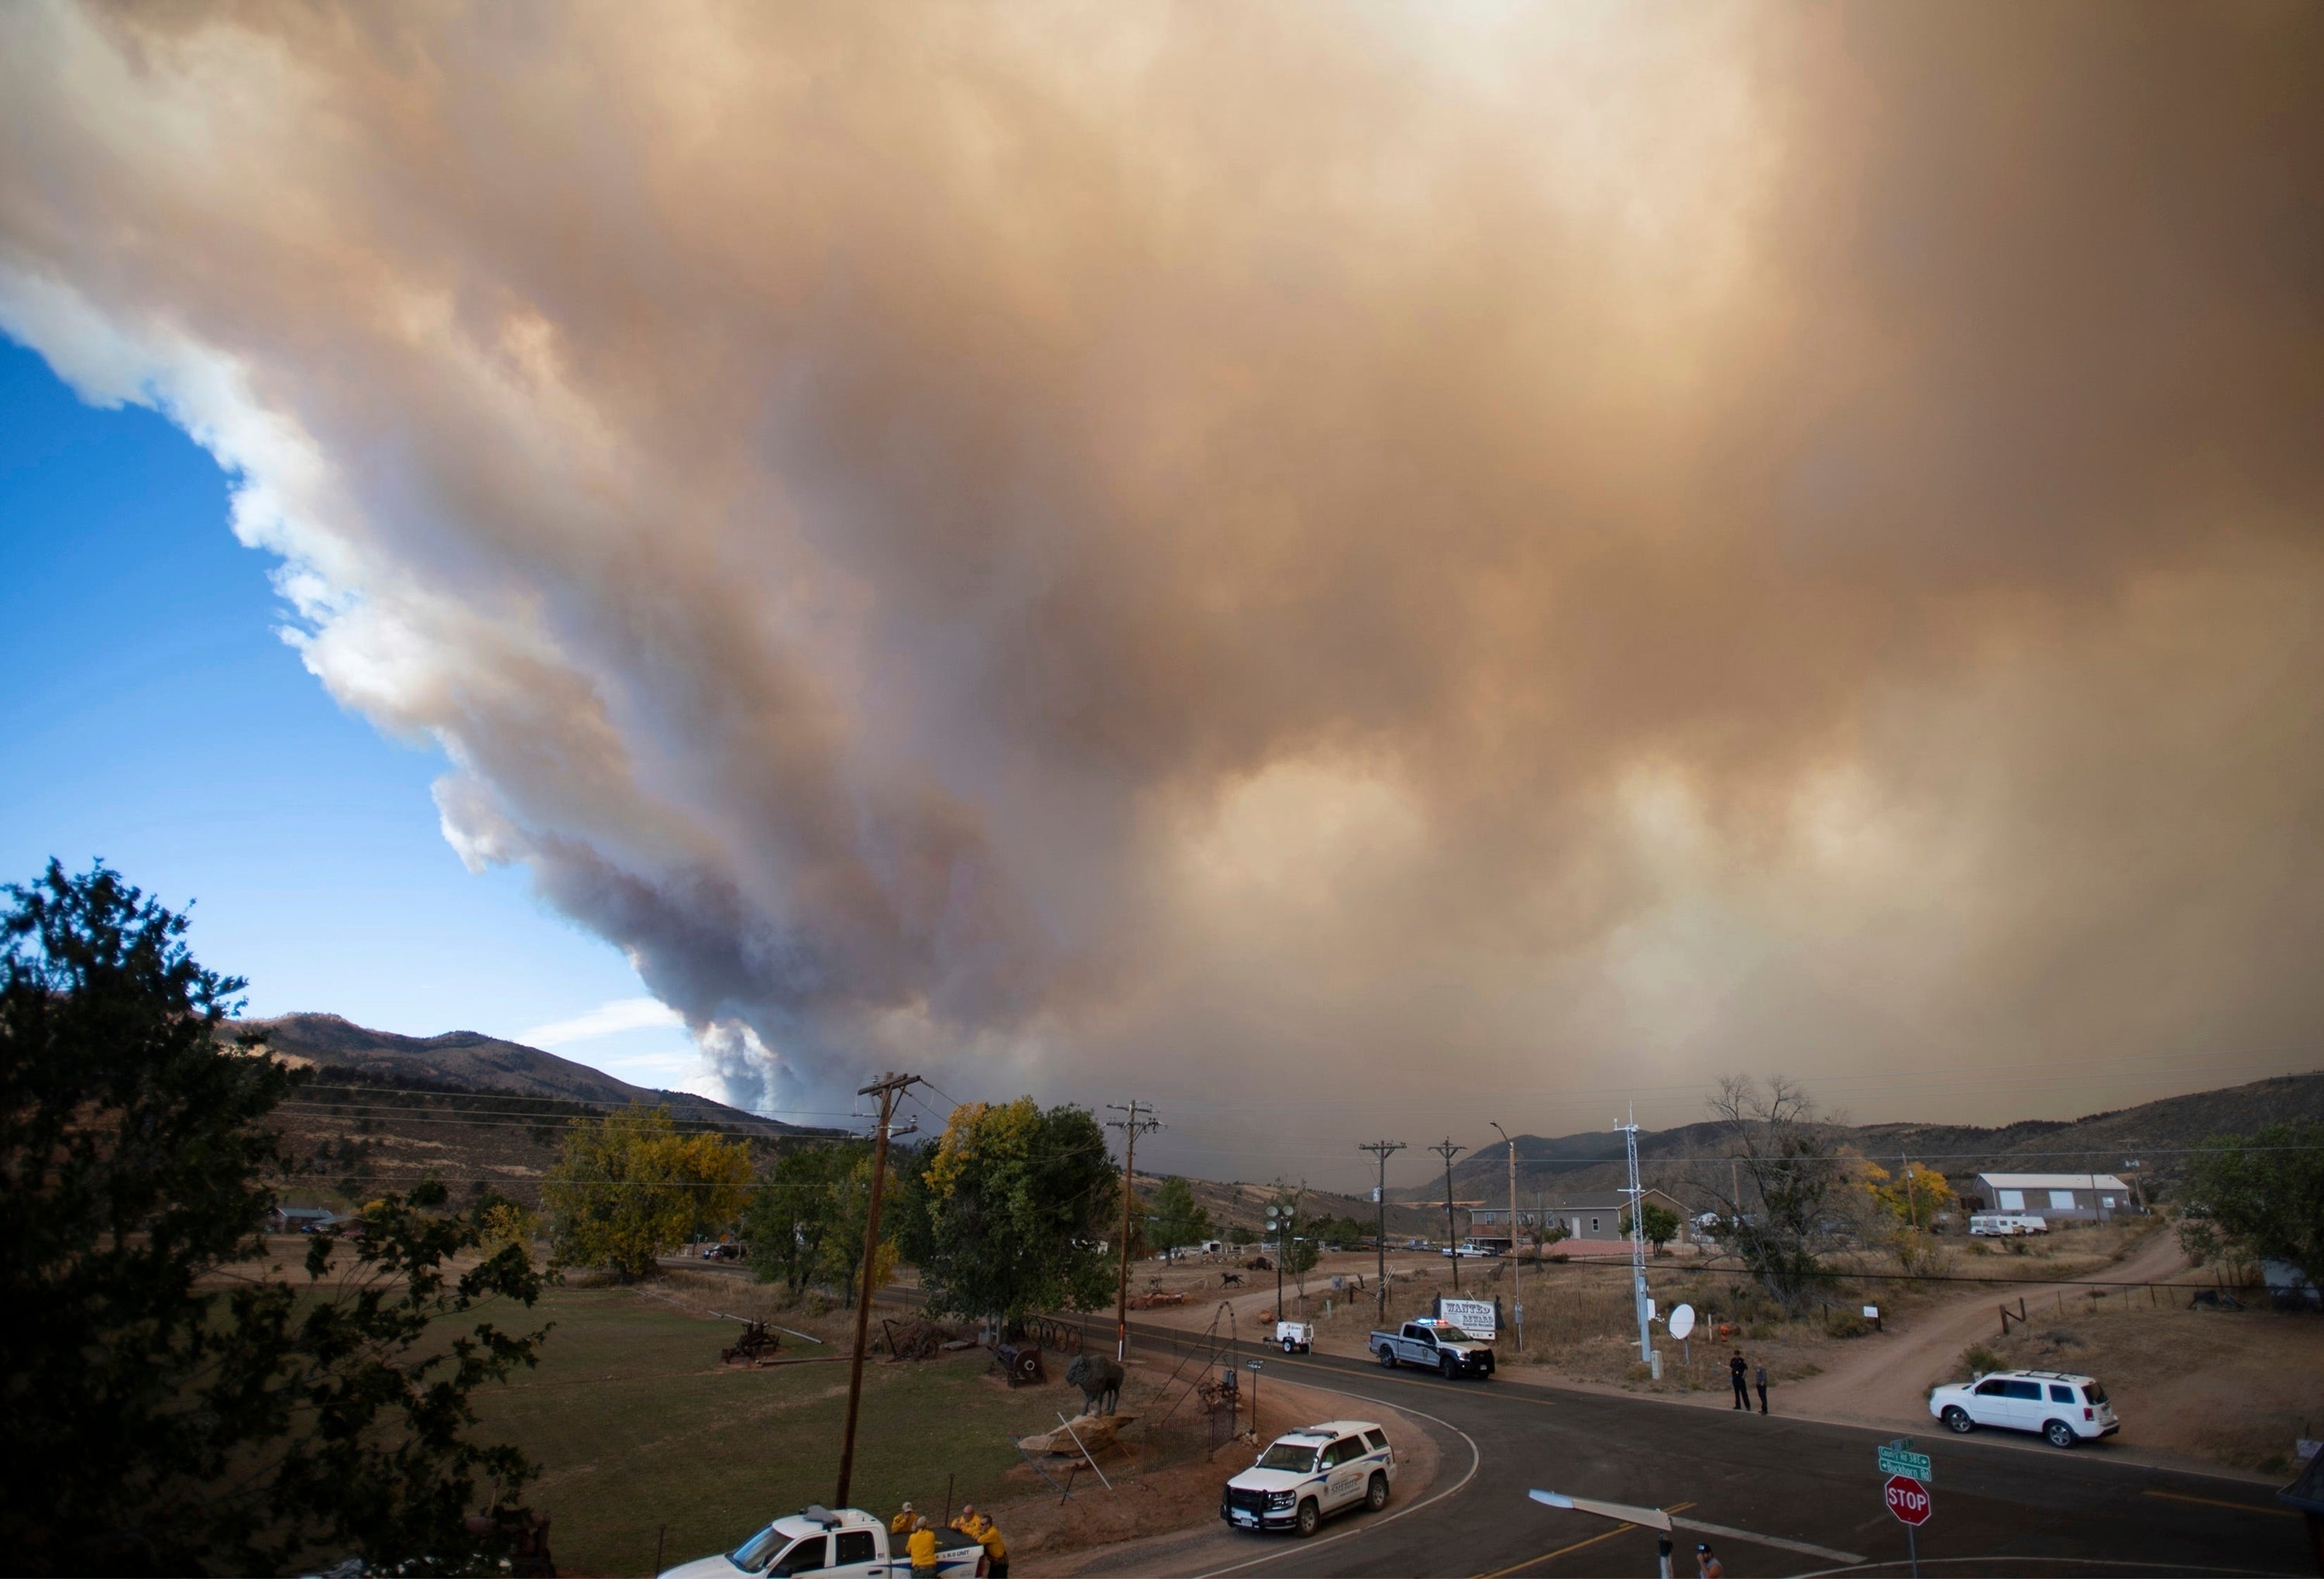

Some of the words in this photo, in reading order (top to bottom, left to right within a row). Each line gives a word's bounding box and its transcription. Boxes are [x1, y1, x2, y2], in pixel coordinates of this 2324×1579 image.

[1446, 1303, 1490, 1313] WANTED
[1909, 1454, 1921, 1464] 38E
[1887, 1463, 1918, 1478] Buckhorn
[1920, 1470, 1930, 1480] Rd
[1889, 1488, 1926, 1511] STOP
